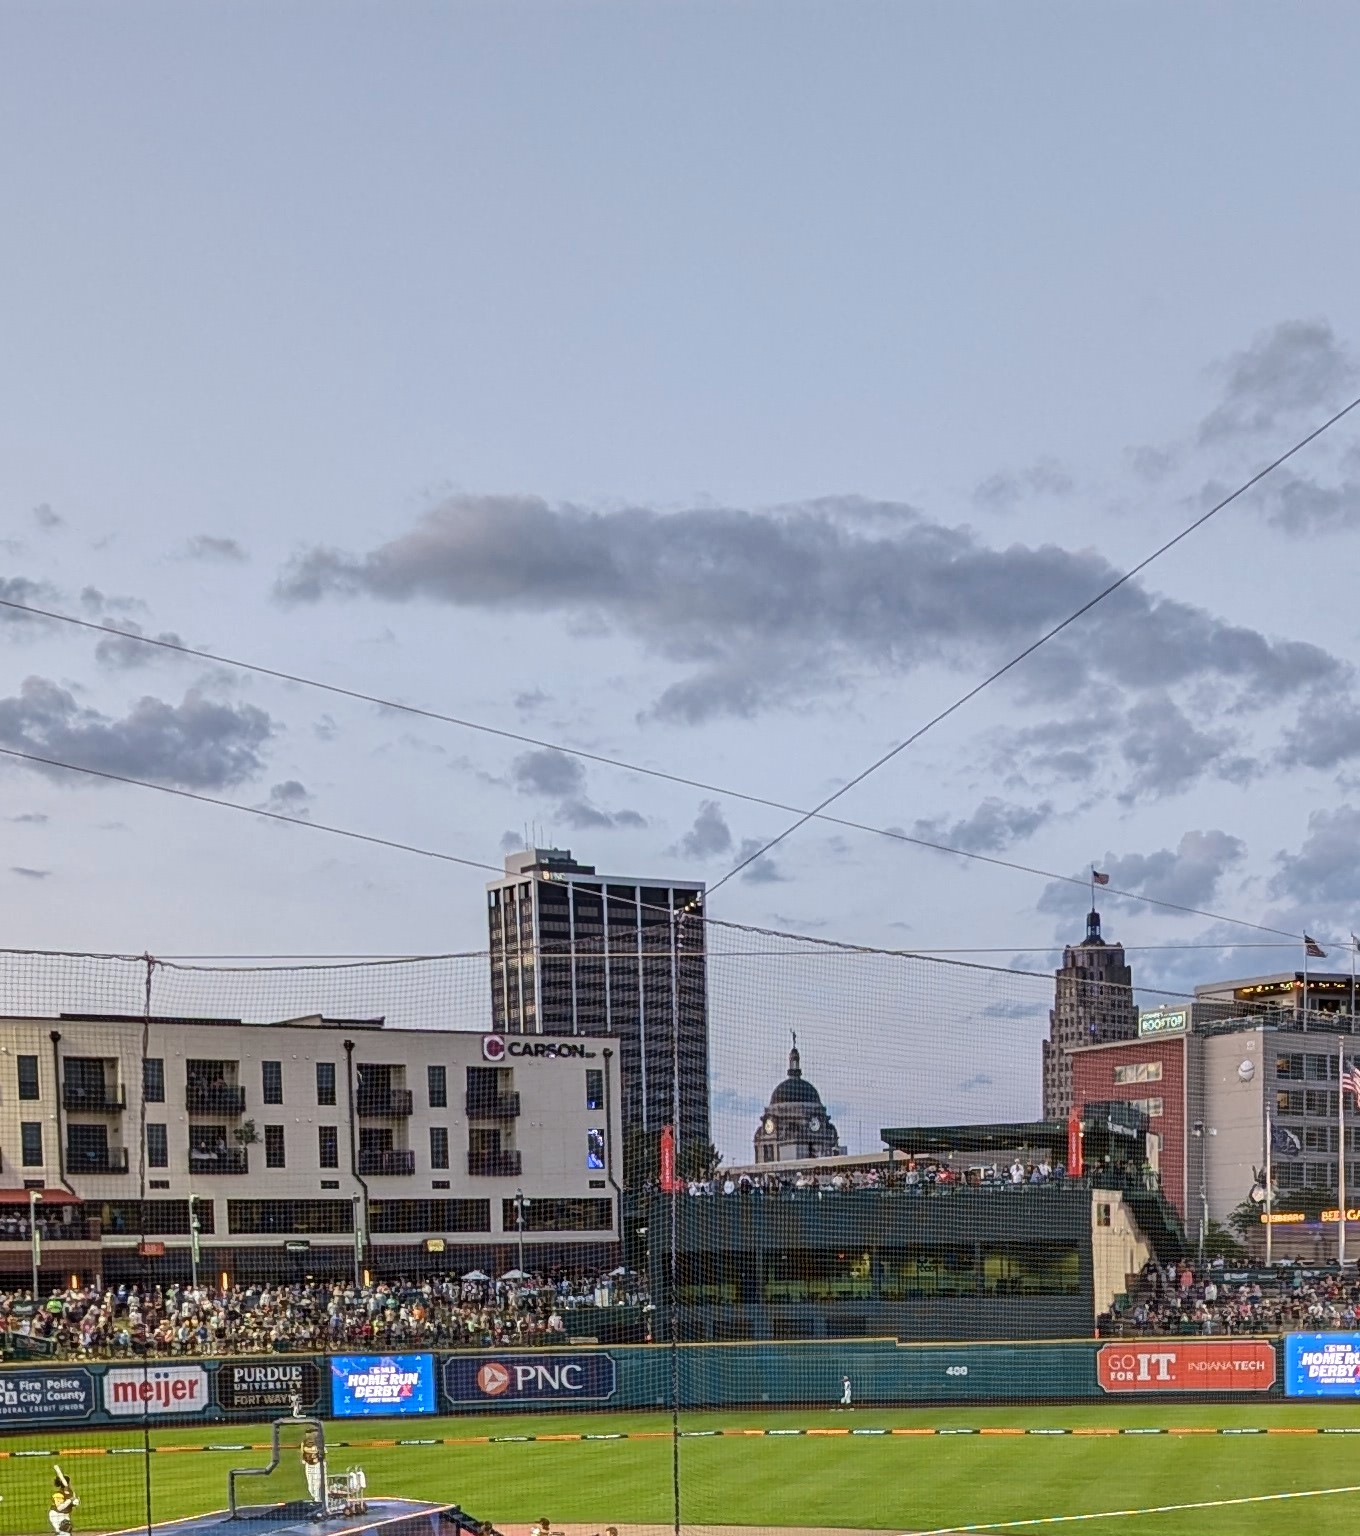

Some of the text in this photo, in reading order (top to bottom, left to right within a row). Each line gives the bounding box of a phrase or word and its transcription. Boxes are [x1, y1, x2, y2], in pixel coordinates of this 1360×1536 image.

[508, 1042, 584, 1058] CARSON
[1108, 1355, 1135, 1370] GO
[1302, 1352, 1343, 1366] HOME
[234, 1366, 302, 1382] PURDUE
[514, 1365, 583, 1390] PNC
[946, 1366, 968, 1376] 400
[1110, 1371, 1134, 1381] FOR
[1308, 1364, 1356, 1377] DERBY
[19, 1378, 80, 1391] Fire Police
[234, 1381, 302, 1391] UNIVERSITY
[348, 1372, 418, 1387] HOME RUN
[113, 1372, 198, 1407] meijer
[355, 1385, 400, 1397] DERBY
[19, 1390, 86, 1404] City County
[234, 1394, 262, 1406] FORT
